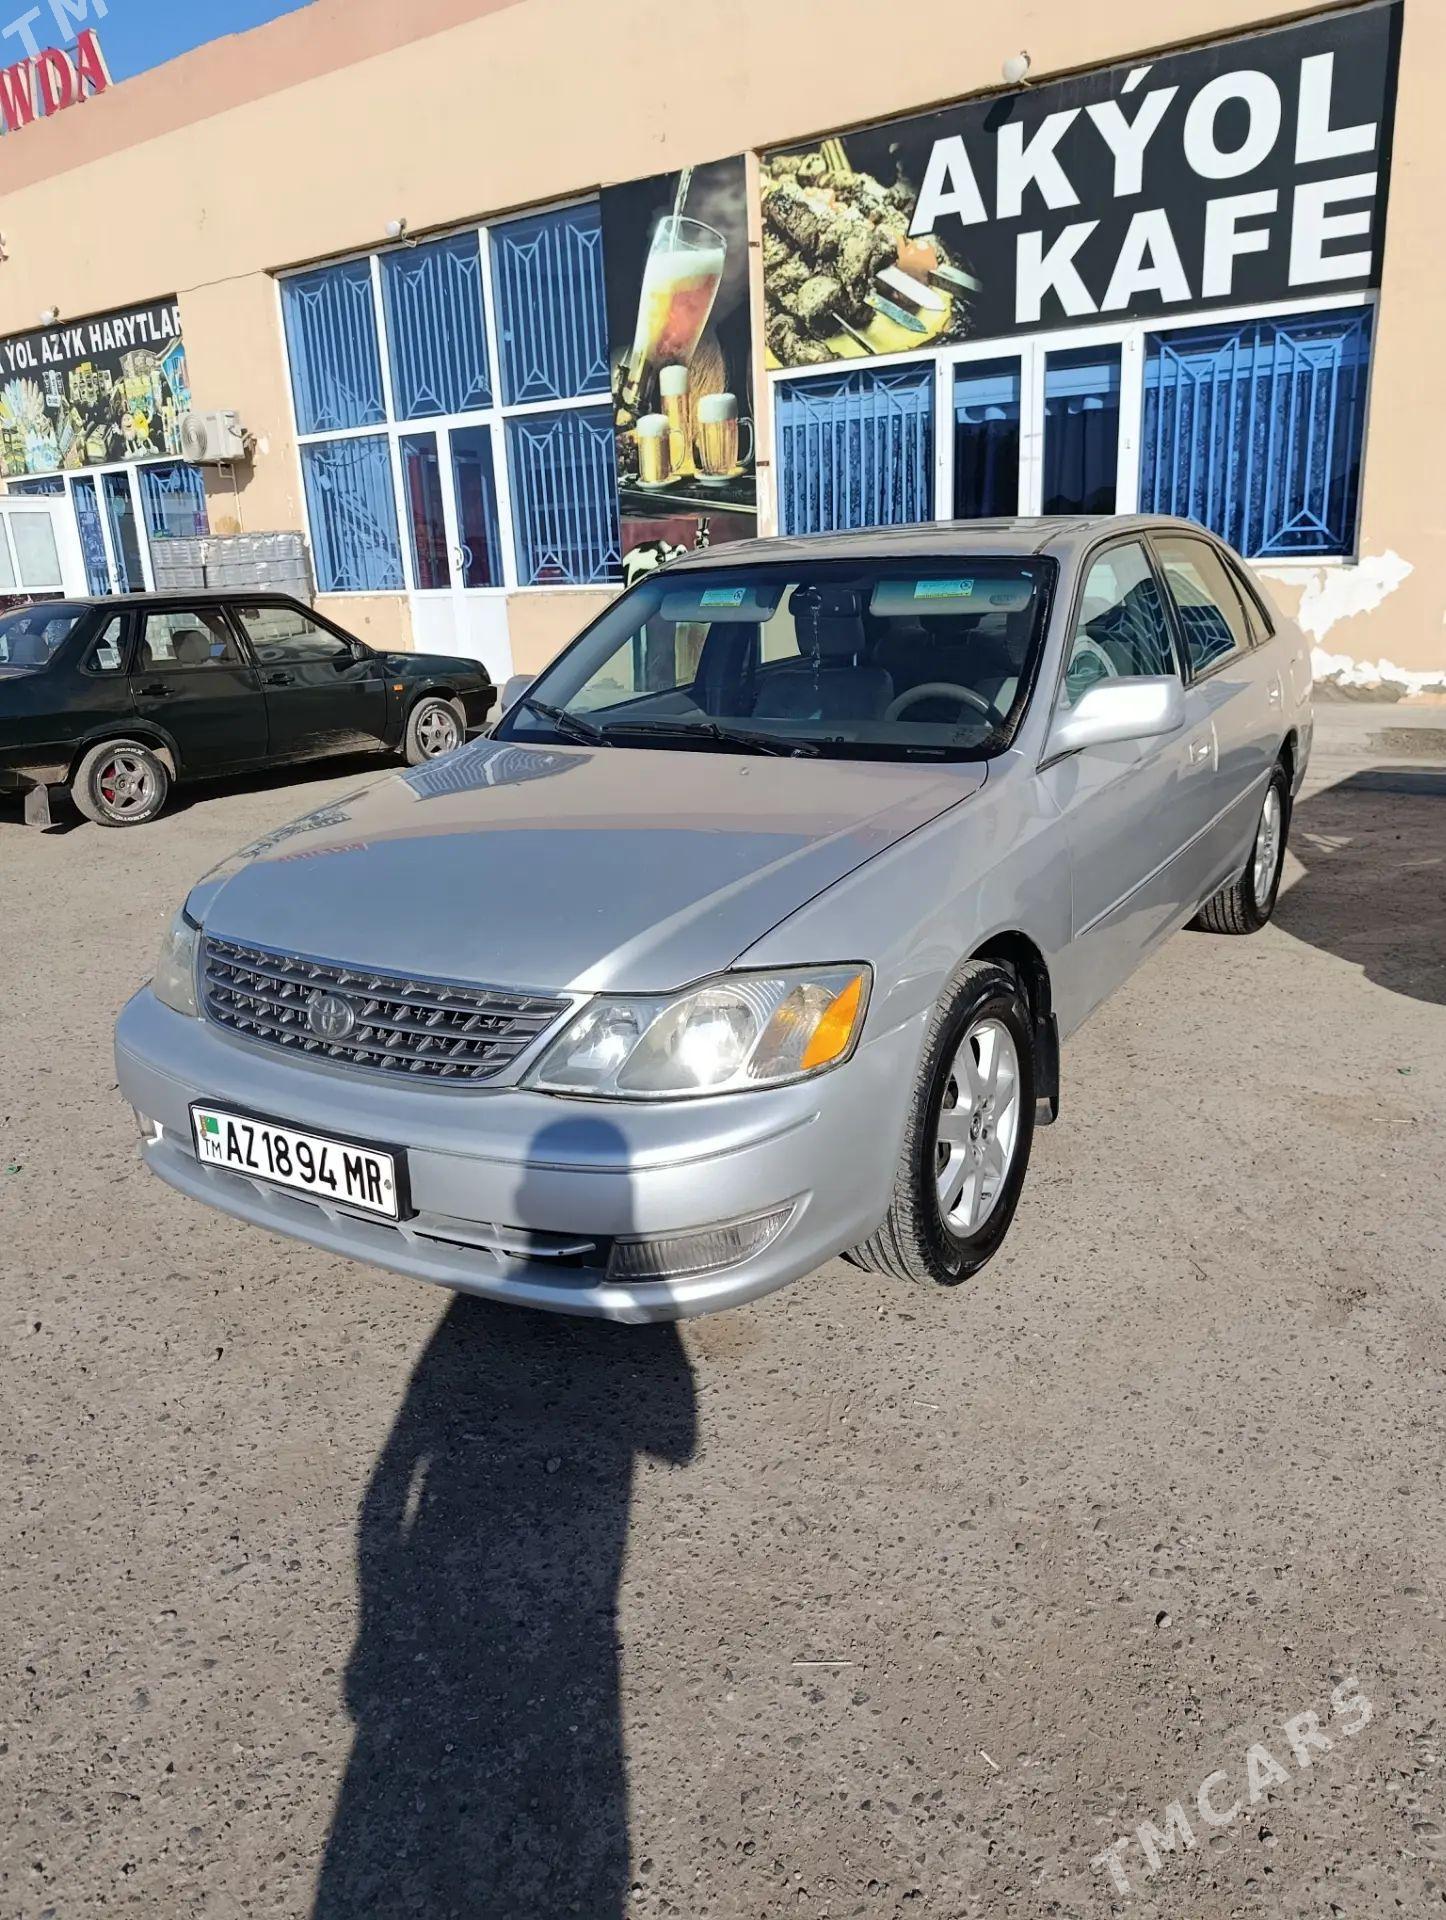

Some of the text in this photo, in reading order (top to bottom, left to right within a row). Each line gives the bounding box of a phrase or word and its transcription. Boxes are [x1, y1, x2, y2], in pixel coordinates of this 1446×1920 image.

[908, 51, 1378, 238] AKÝOL
[1014, 171, 1378, 324] KAFE
[4, 339, 38, 371] ÝOL
[41, 327, 87, 364] AZYK
[204, 1138, 222, 1159] TM
